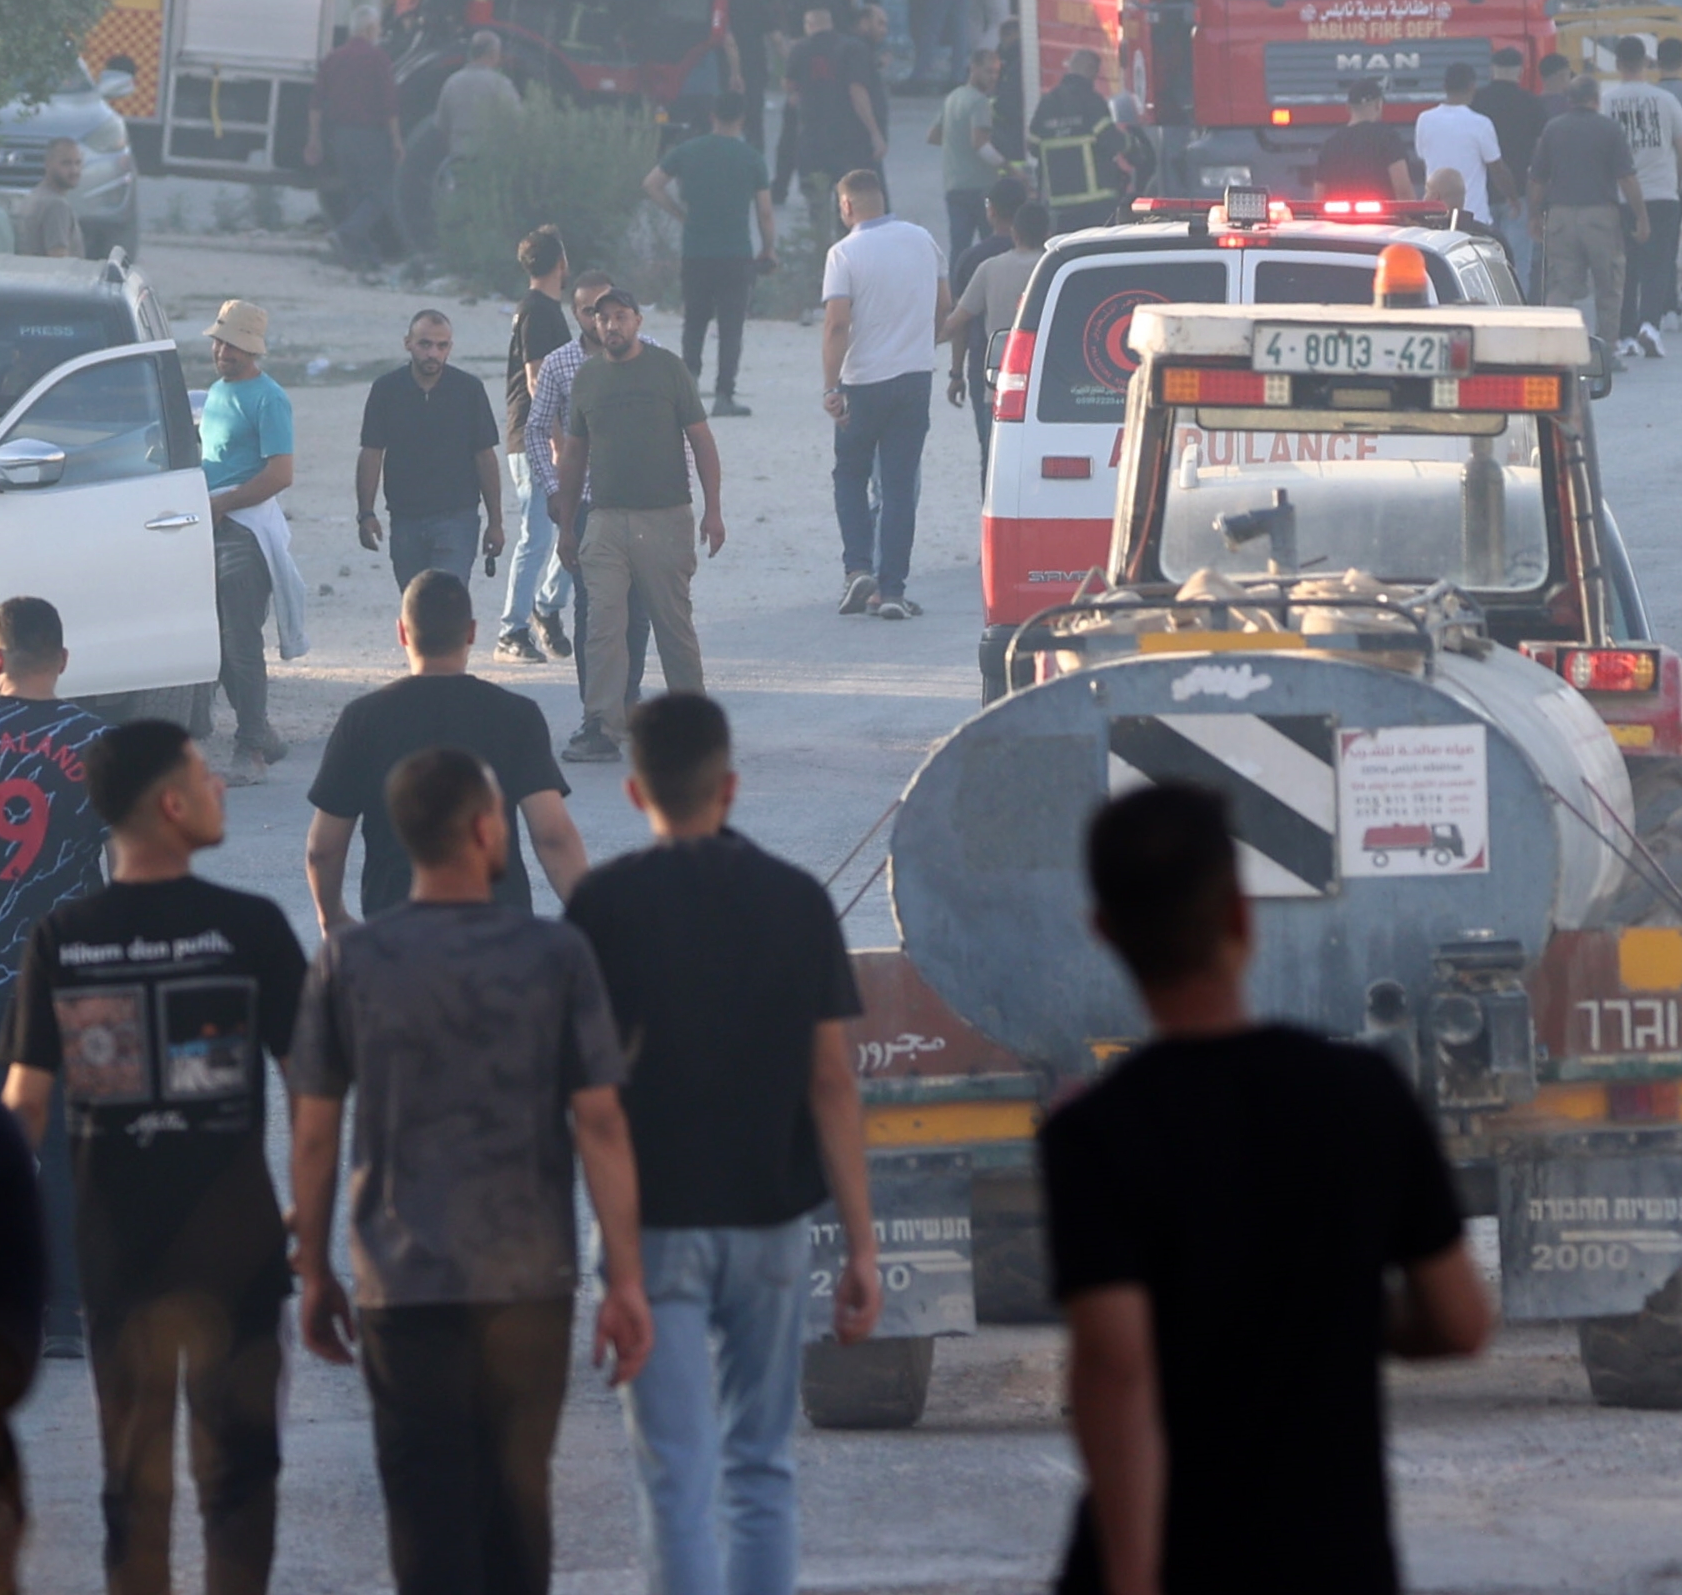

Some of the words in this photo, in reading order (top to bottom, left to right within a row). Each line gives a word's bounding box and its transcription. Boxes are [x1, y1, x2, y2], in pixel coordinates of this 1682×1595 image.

[1307, 23, 1366, 40] NABLUS
[1370, 22, 1403, 39] FIRE
[1337, 53, 1419, 71] MAN
[20, 326, 74, 336] PRESS
[857, 1032, 946, 1072] مجرور
[1532, 1243, 1630, 1272] 2000
